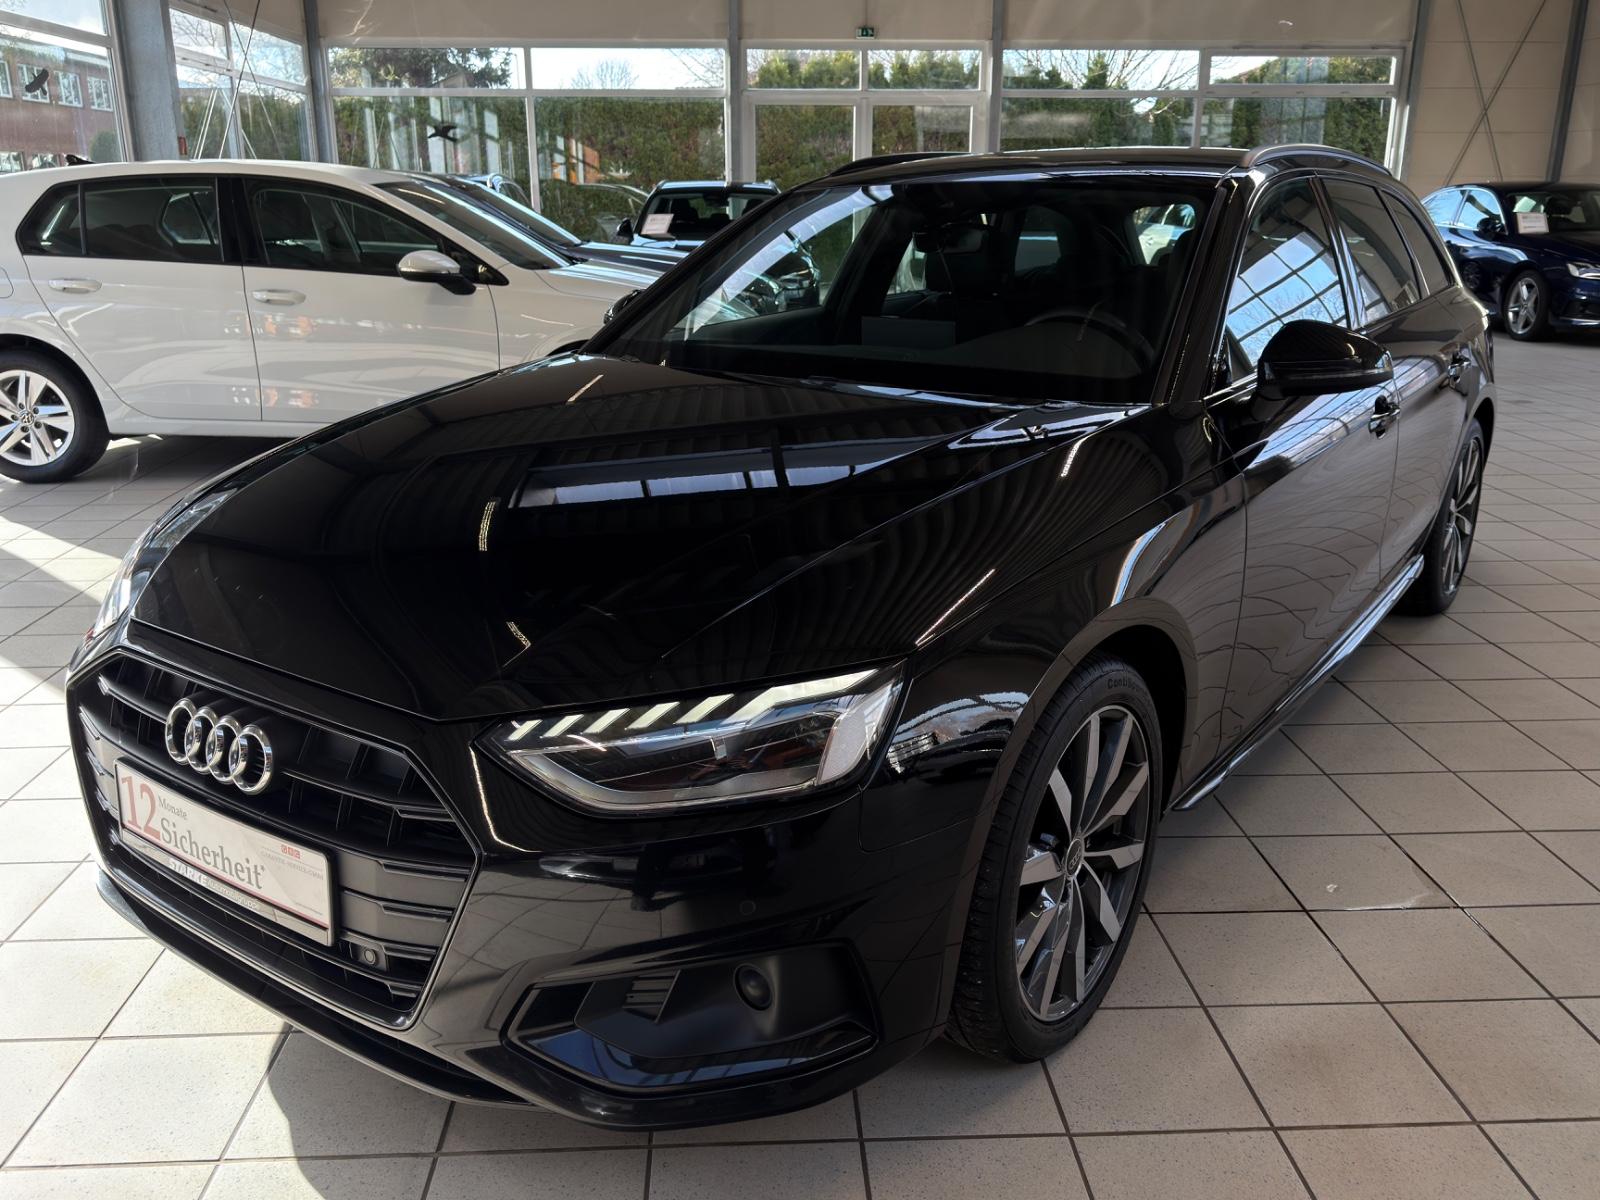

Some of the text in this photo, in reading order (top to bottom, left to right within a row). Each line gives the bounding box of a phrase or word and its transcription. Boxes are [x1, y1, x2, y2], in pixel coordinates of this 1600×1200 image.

[122, 776, 161, 840] 12
[158, 795, 188, 819] Monate
[168, 859, 208, 887] STARKE
